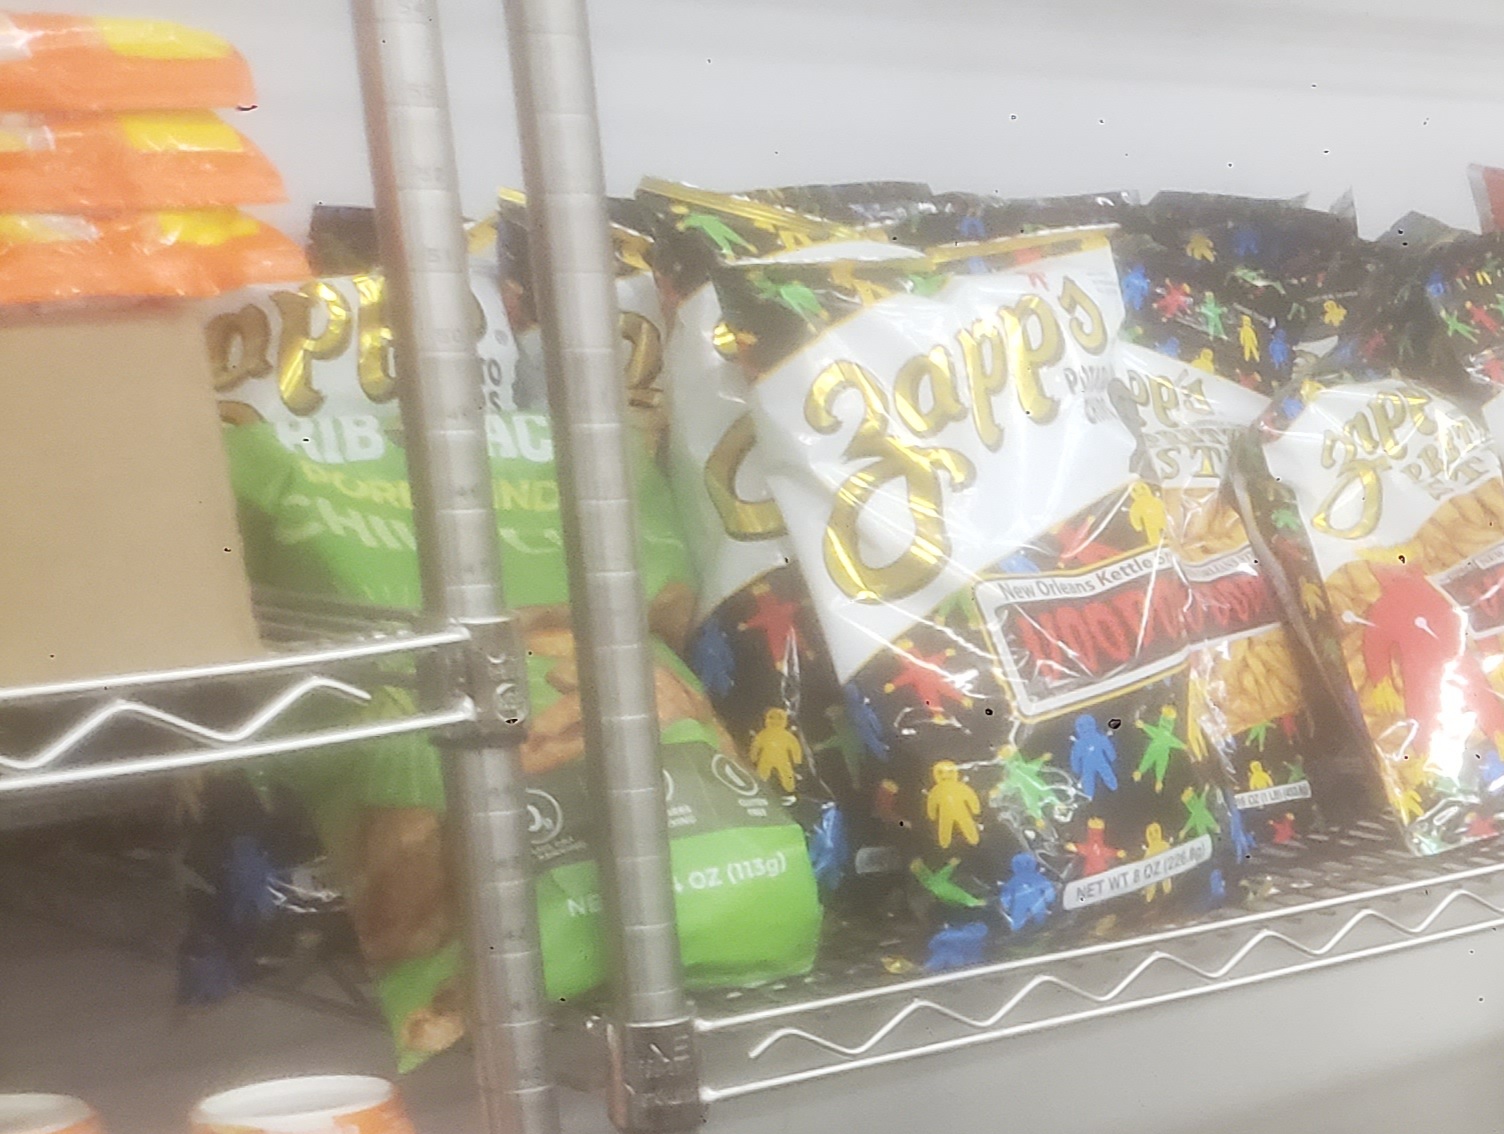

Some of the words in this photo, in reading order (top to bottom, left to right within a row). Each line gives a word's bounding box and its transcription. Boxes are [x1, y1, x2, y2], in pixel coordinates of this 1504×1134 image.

[998, 582, 1035, 601] New
[1036, 577, 1096, 598] Orleans
[1096, 556, 1152, 586] Kettle
[567, 893, 601, 917] NE
[688, 867, 721, 889] OZ
[727, 851, 787, 884] (113g)
[1076, 878, 1105, 901] NET
[1108, 872, 1129, 891] WT
[1133, 869, 1140, 884] 8
[1144, 860, 1162, 879] OZ
